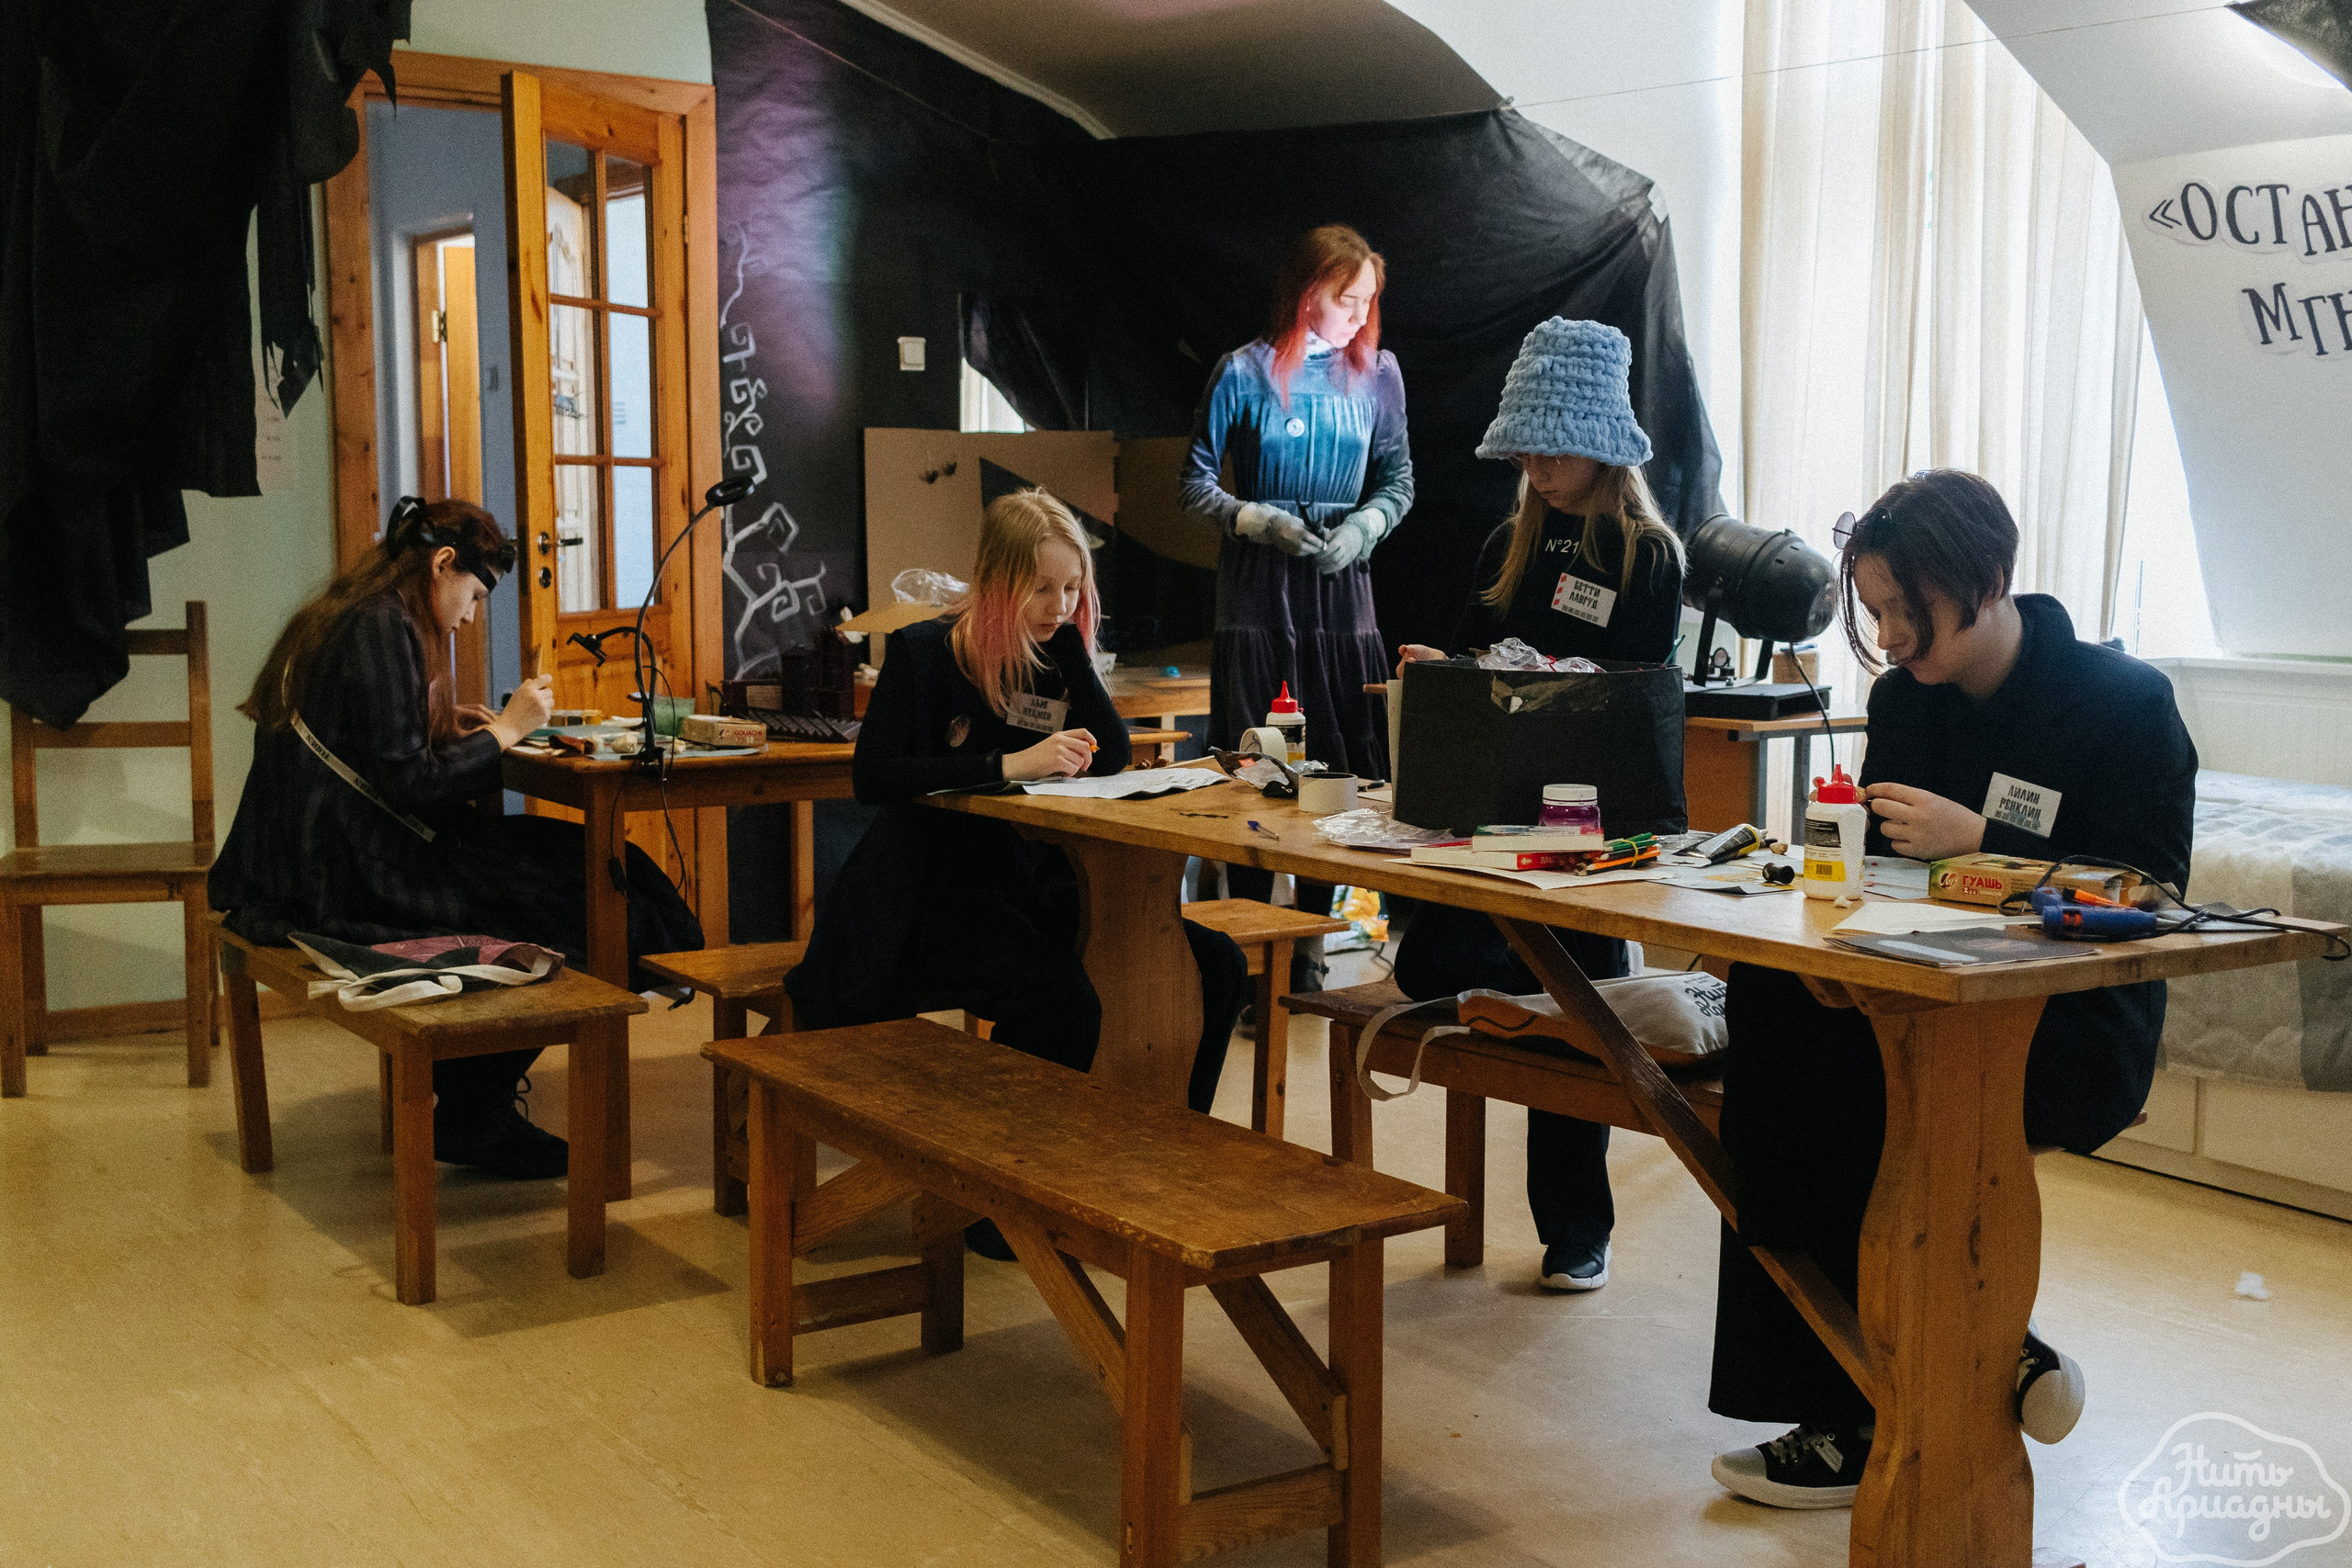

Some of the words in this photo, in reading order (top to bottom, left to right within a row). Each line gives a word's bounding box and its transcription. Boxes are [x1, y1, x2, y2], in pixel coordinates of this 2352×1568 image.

[1574, 581, 1601, 597] БЕТТИ
[1569, 592, 1599, 609] ЛАВГУД
[1999, 796, 2041, 820] РЕНКЛИН
[1962, 874, 2002, 890] ГУАШЬ
